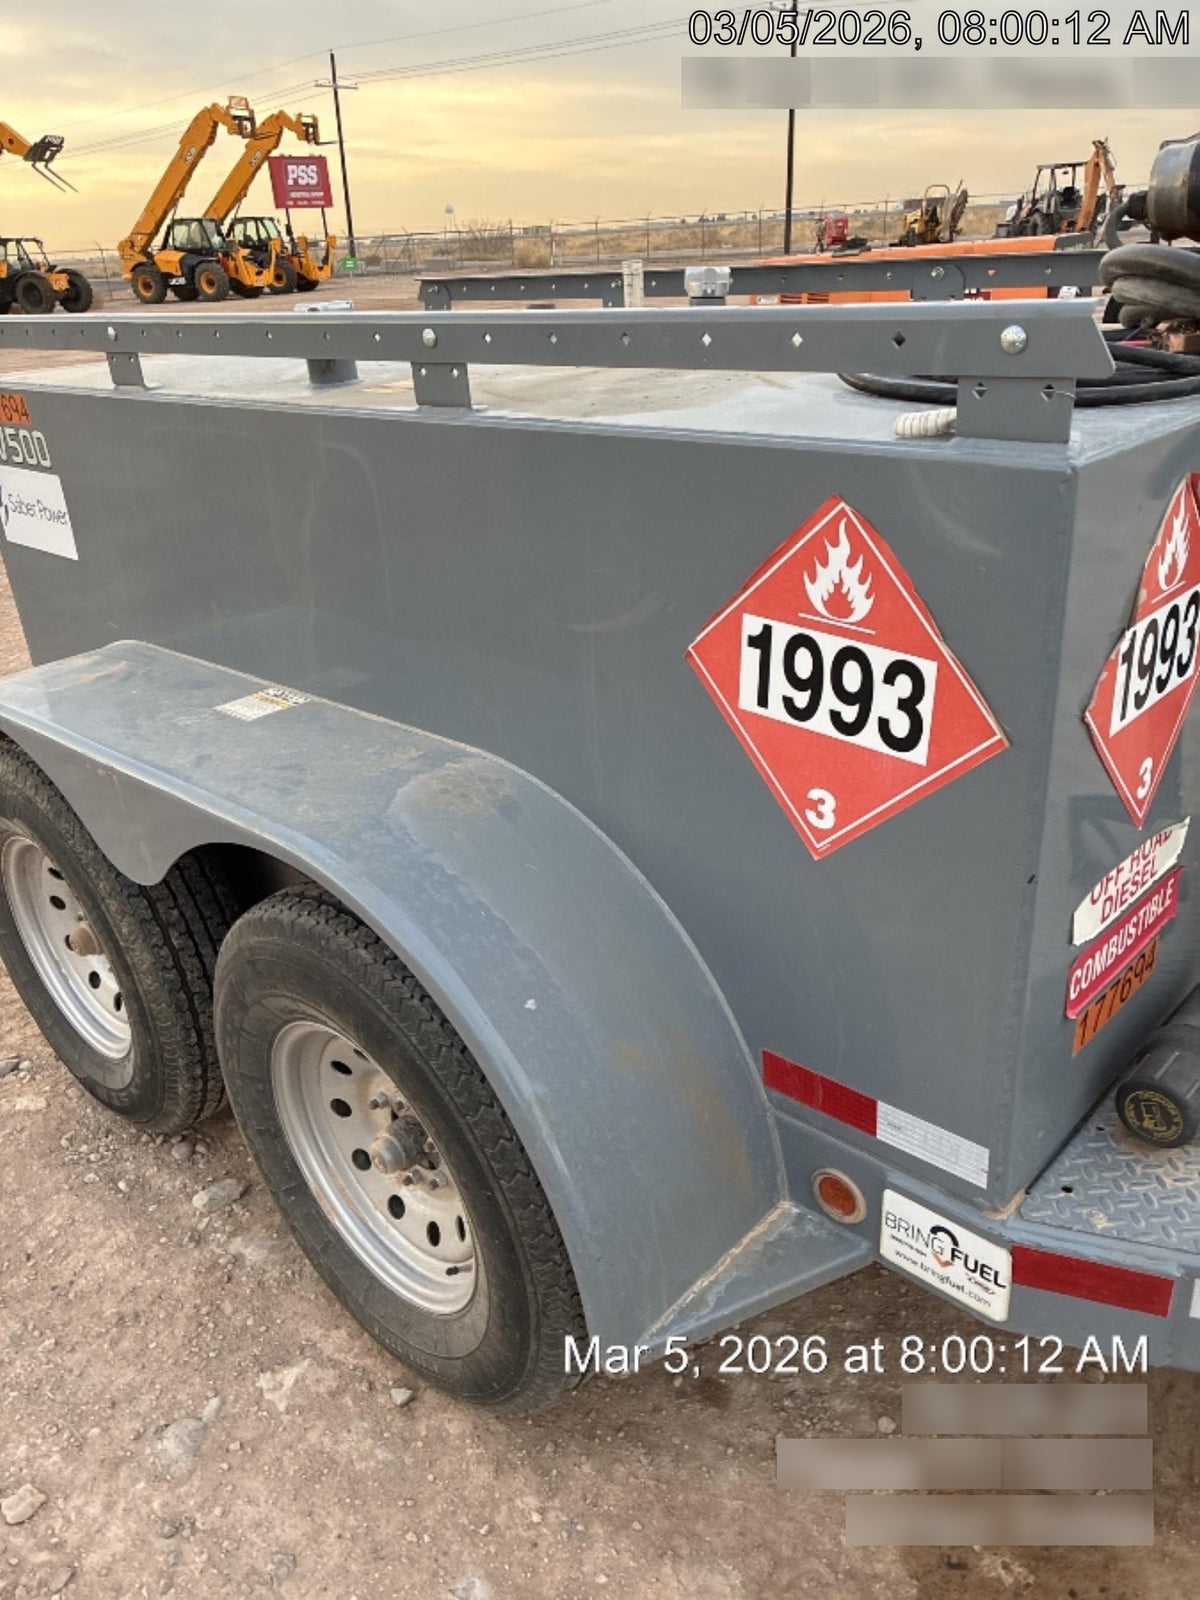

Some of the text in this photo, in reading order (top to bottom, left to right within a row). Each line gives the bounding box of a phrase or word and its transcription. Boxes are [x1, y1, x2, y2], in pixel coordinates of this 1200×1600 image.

[287, 165, 318, 185] PSS
[747, 624, 926, 753] 1993
[1120, 590, 1200, 723] 1993
[805, 788, 836, 829] 3
[1137, 757, 1153, 799] 3
[1101, 855, 1157, 924] DIESEL
[1070, 878, 1175, 1000] COMBUSTIBLE
[1079, 939, 1157, 1046] 177694
[894, 1250, 992, 1308] www.bringfuel.com
